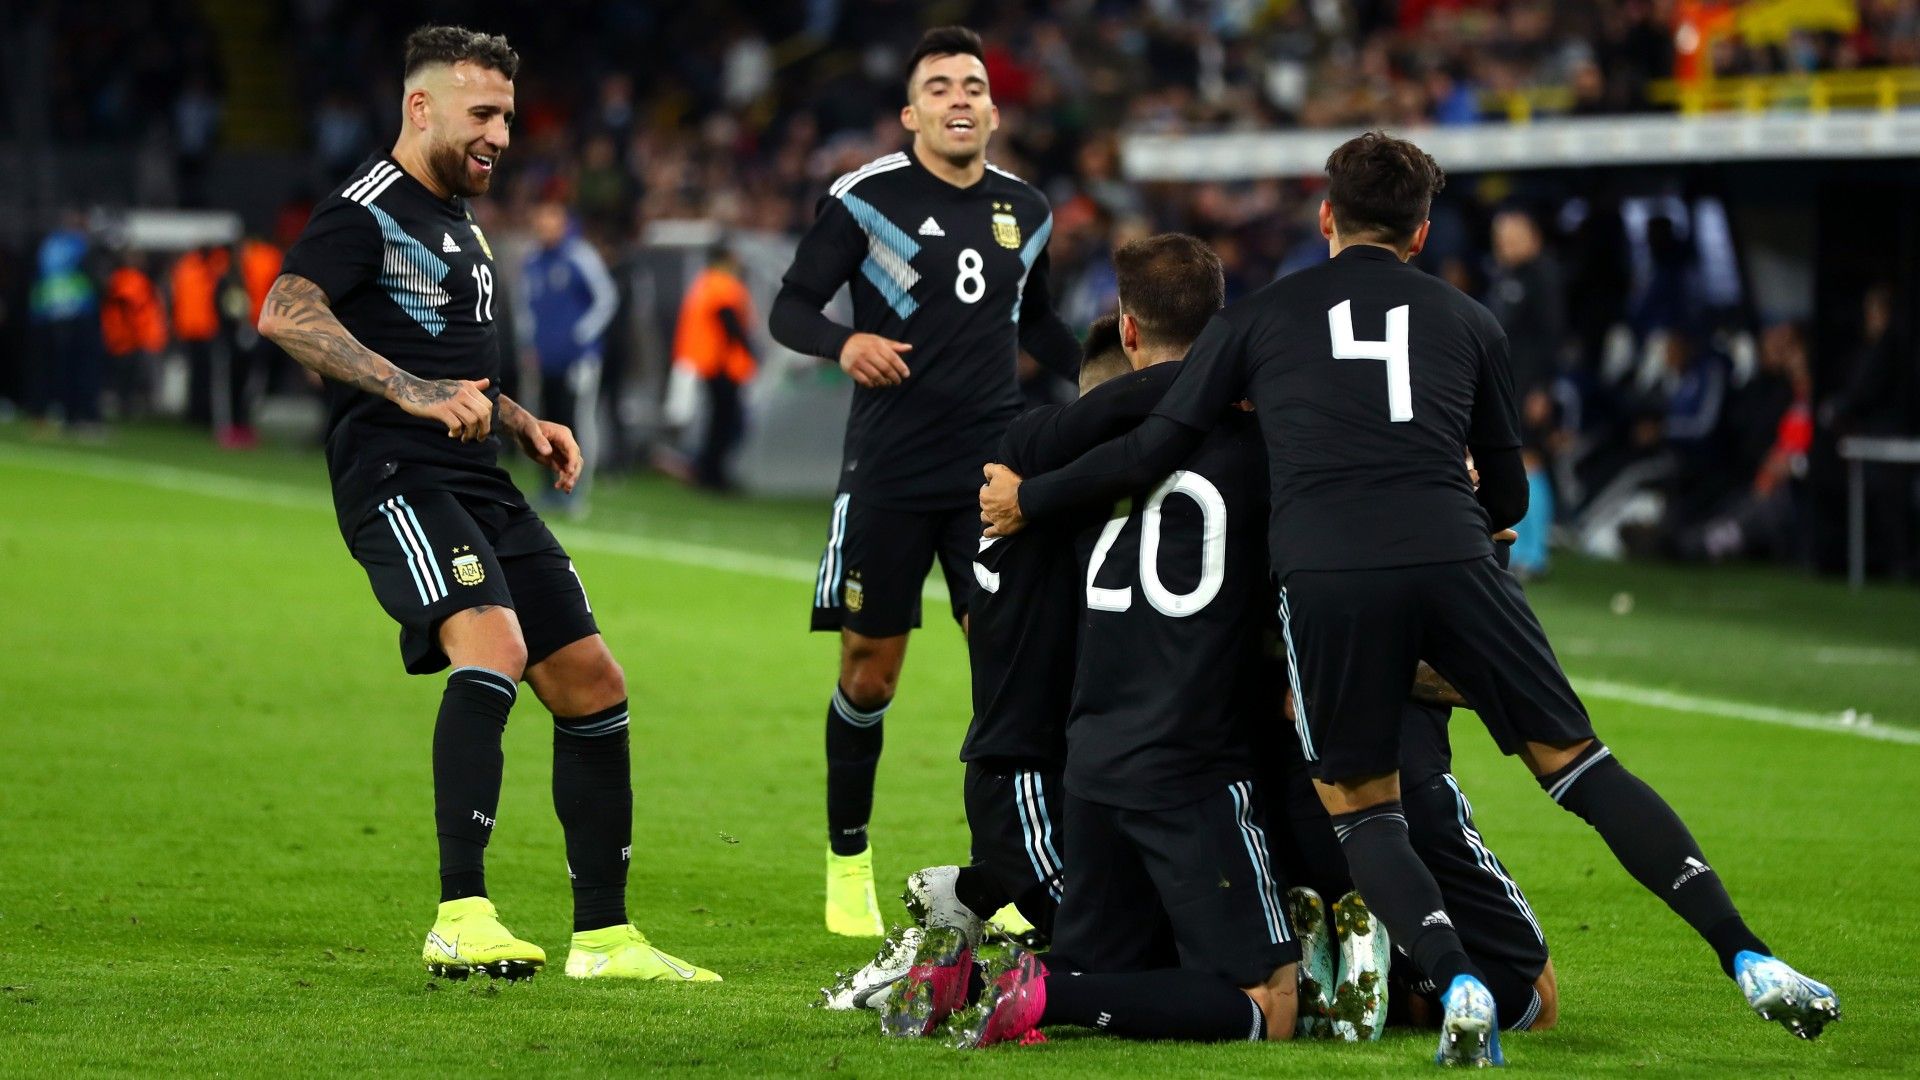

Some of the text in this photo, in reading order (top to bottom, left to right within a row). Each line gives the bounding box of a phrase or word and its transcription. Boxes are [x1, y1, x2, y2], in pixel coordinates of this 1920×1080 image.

[471, 263, 493, 322] 19
[955, 248, 986, 304] 8
[1327, 299, 1414, 422] 4
[1086, 470, 1227, 618] 20
